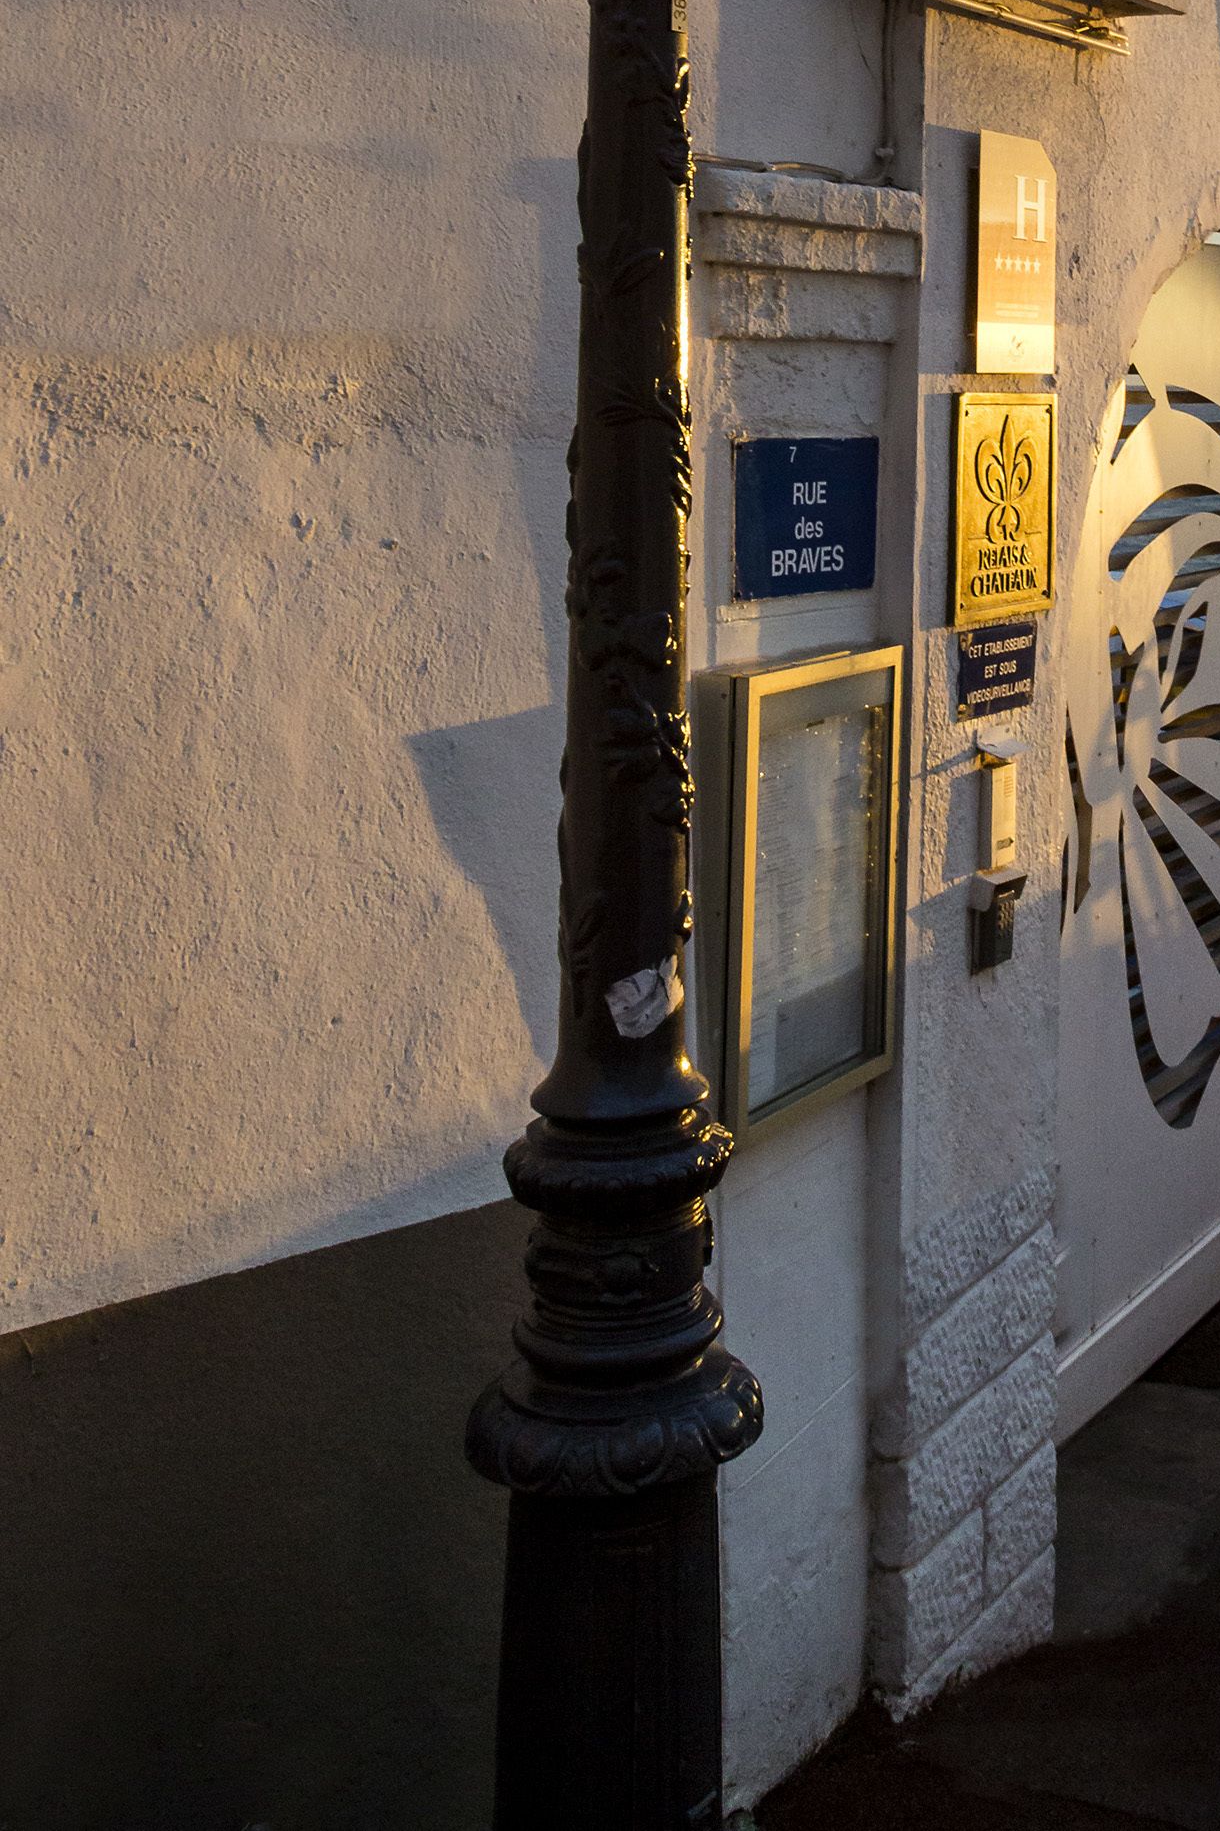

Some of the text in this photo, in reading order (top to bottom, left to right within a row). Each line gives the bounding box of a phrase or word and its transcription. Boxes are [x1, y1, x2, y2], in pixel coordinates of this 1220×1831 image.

[1013, 174, 1050, 243] H
[789, 445, 798, 463] 7
[792, 481, 828, 506] RUE
[794, 515, 824, 540] des
[771, 544, 845, 577] BRAVES
[970, 566, 1038, 598] CHATEAUX
[968, 634, 1034, 659] CET ETABLISSEMENT
[984, 659, 1018, 679] EST SOUS
[966, 678, 1032, 705] VIDEOSURVEILLANCE
